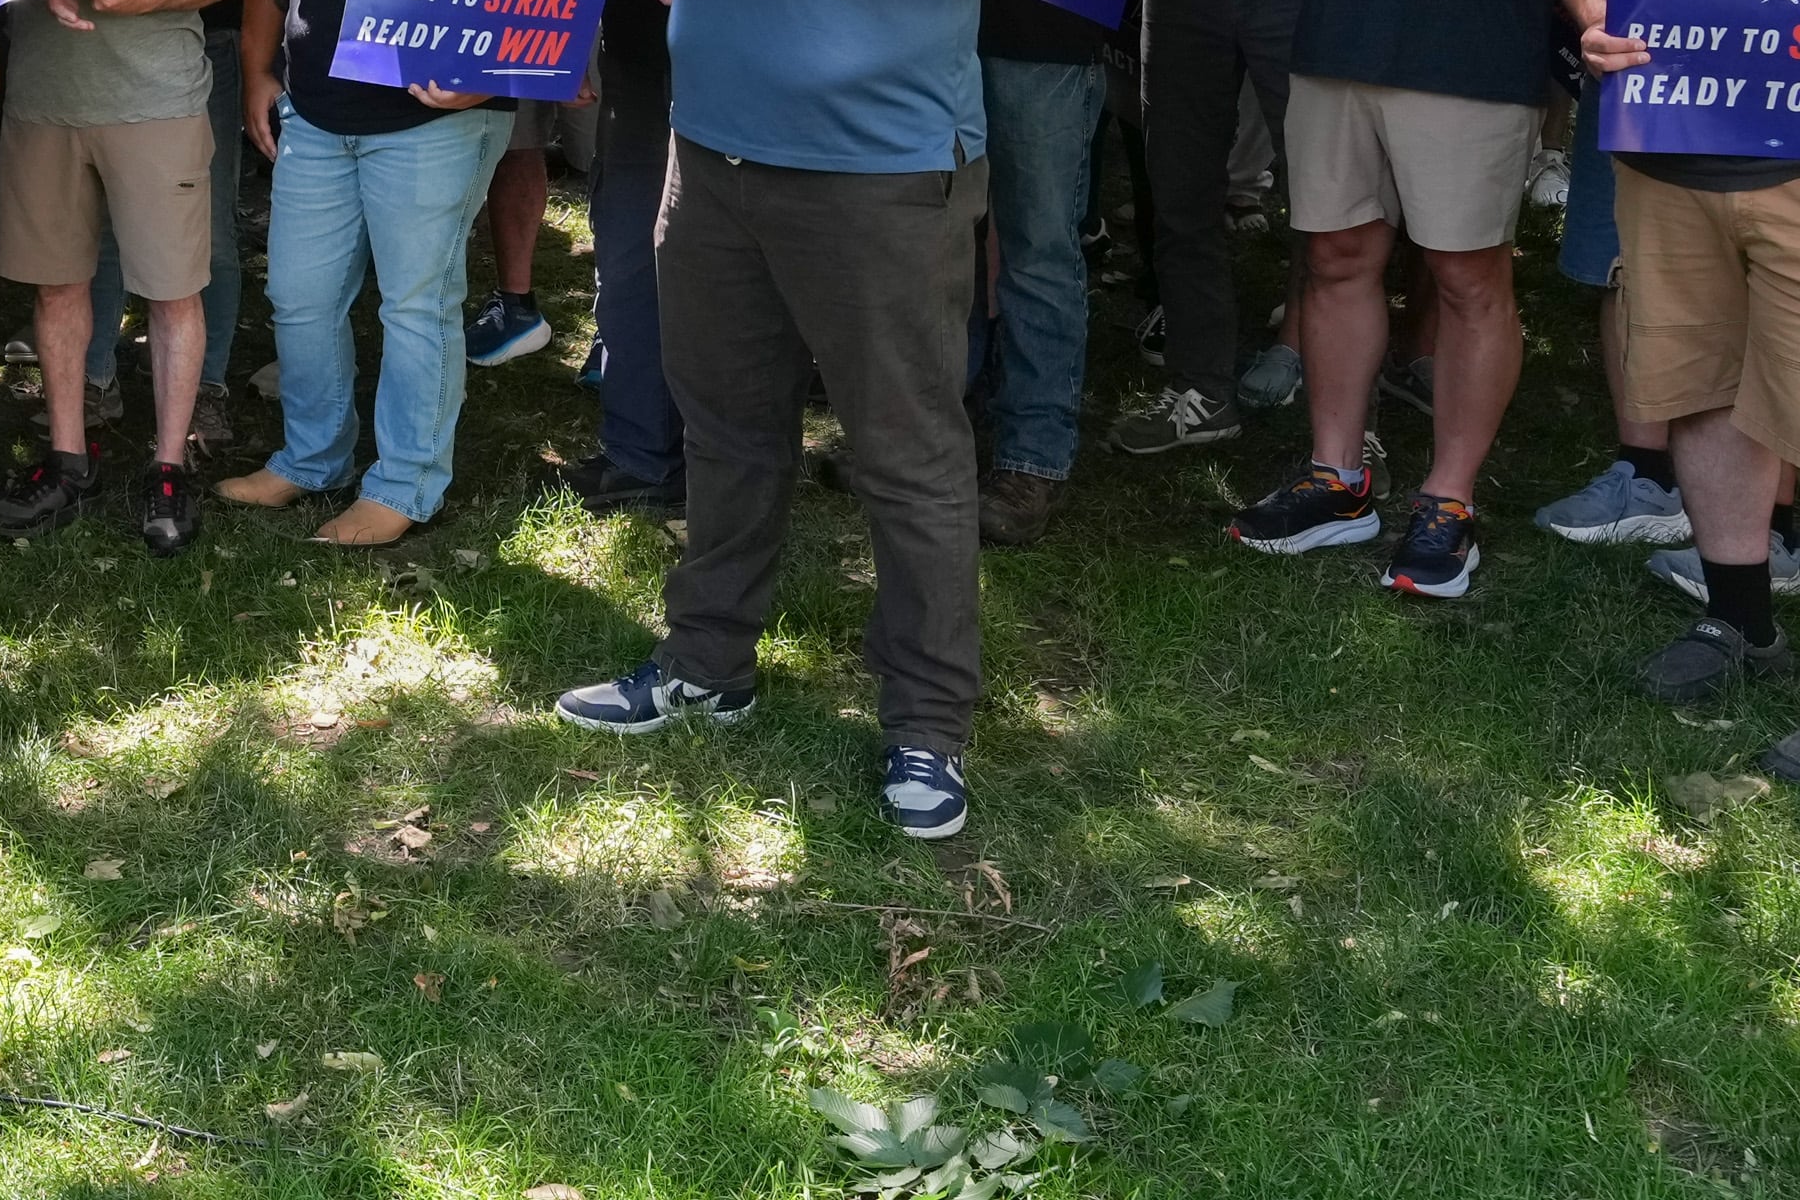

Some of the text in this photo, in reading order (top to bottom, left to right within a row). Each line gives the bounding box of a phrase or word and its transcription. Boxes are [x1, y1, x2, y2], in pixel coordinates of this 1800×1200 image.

[356, 16, 571, 66] READY TO WIN
[1627, 23, 1728, 51] READY
[1743, 28, 1781, 55] TO
[1623, 74, 1746, 108] READY
